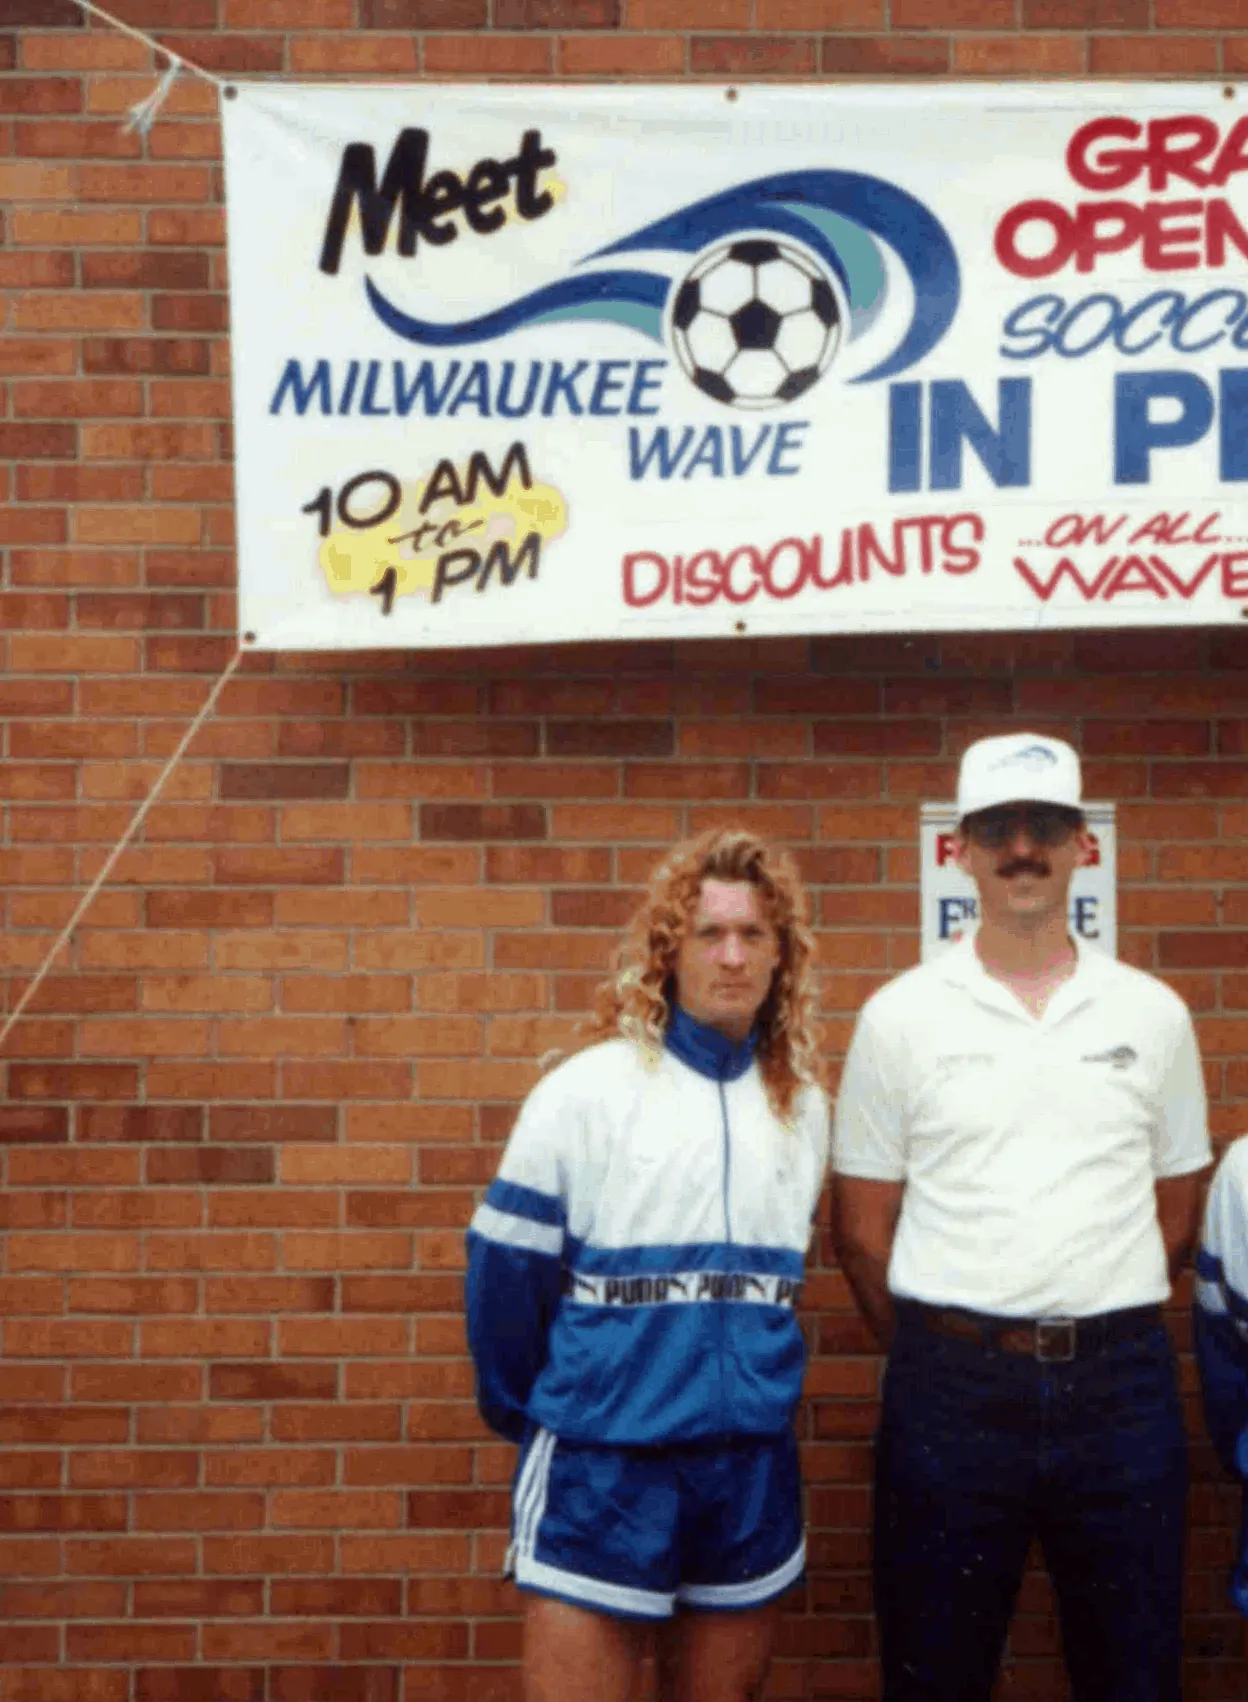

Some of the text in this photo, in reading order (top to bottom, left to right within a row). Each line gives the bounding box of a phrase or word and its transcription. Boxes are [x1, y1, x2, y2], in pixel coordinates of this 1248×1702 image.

[319, 128, 556, 275] Meet
[269, 359, 668, 418] MILWAUKEE
[627, 421, 811, 482] WAVE
[887, 376, 1032, 494] IN
[302, 441, 532, 536] 10 AM
[370, 532, 541, 616] 1 PM
[387, 519, 484, 552] to
[621, 514, 984, 608] DISCOUNTS
